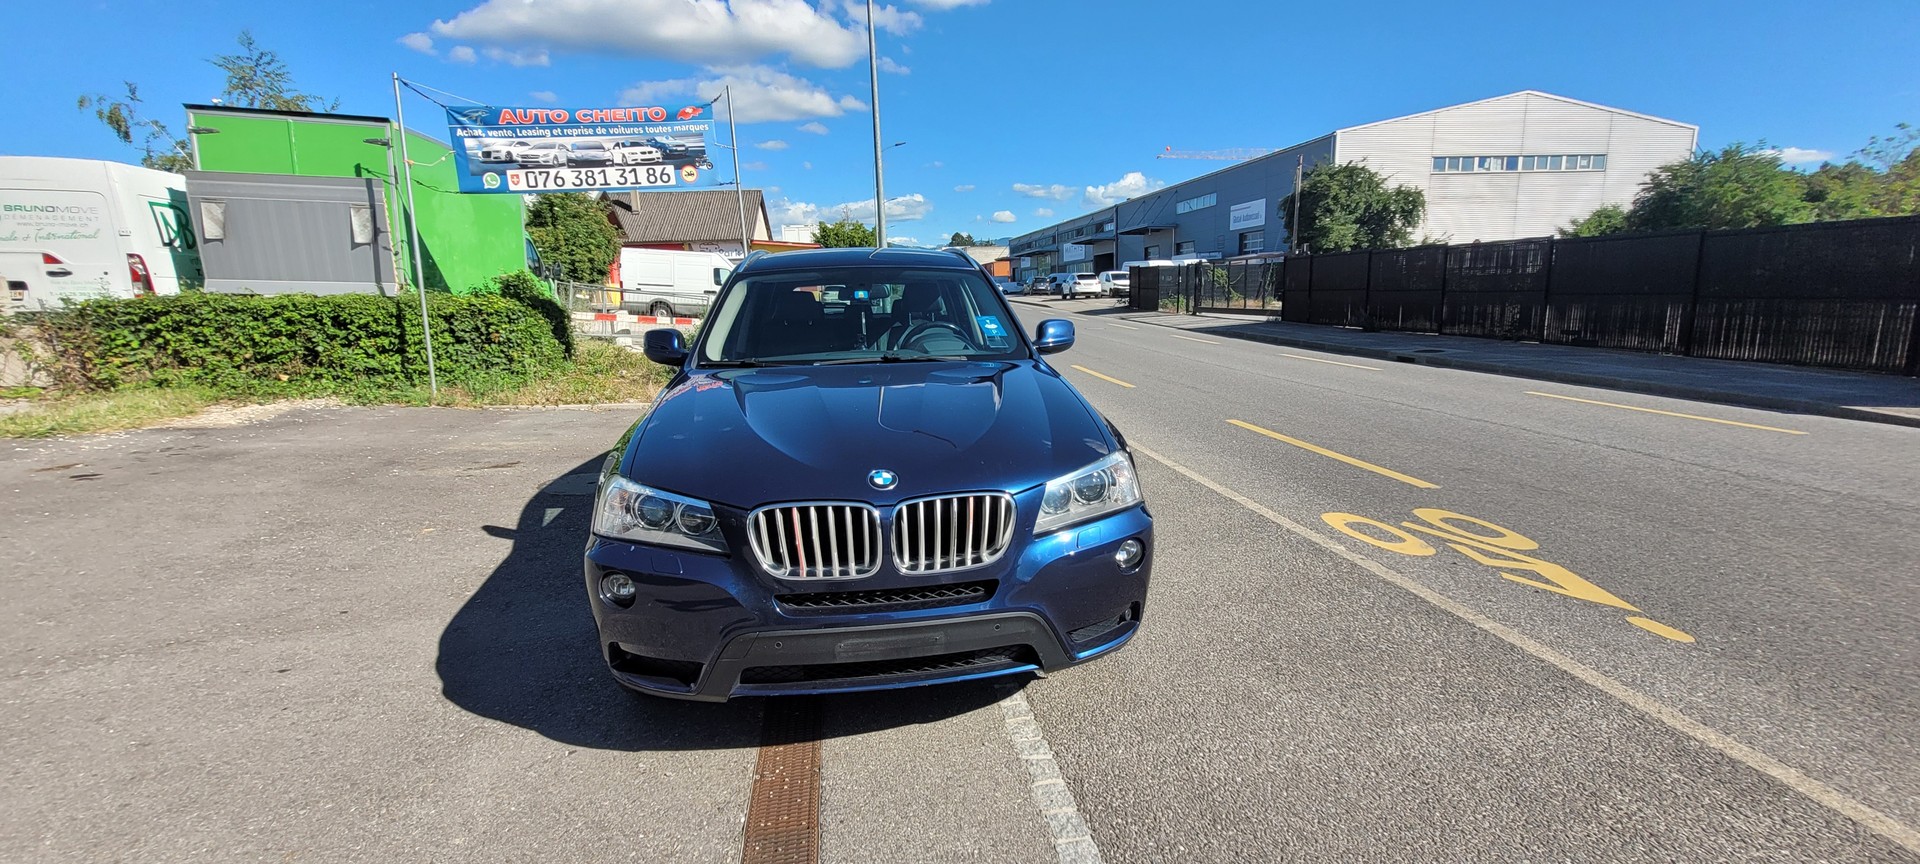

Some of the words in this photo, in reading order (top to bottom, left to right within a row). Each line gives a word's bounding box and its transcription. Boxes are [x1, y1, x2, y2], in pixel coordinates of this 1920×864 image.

[498, 108, 569, 125] AUTO
[575, 106, 667, 123] CHEITO
[456, 127, 486, 138] Achat,
[487, 128, 516, 138] vente,
[517, 127, 550, 138] Leasing
[552, 128, 562, 136] et
[564, 126, 593, 138] reprise
[596, 124, 606, 135] de
[609, 124, 643, 135] voitures
[645, 123, 672, 134] toutes
[674, 123, 709, 133] marques
[524, 170, 566, 188] 076
[571, 169, 612, 187] 381
[615, 168, 642, 186] 31
[646, 167, 671, 184] 86
